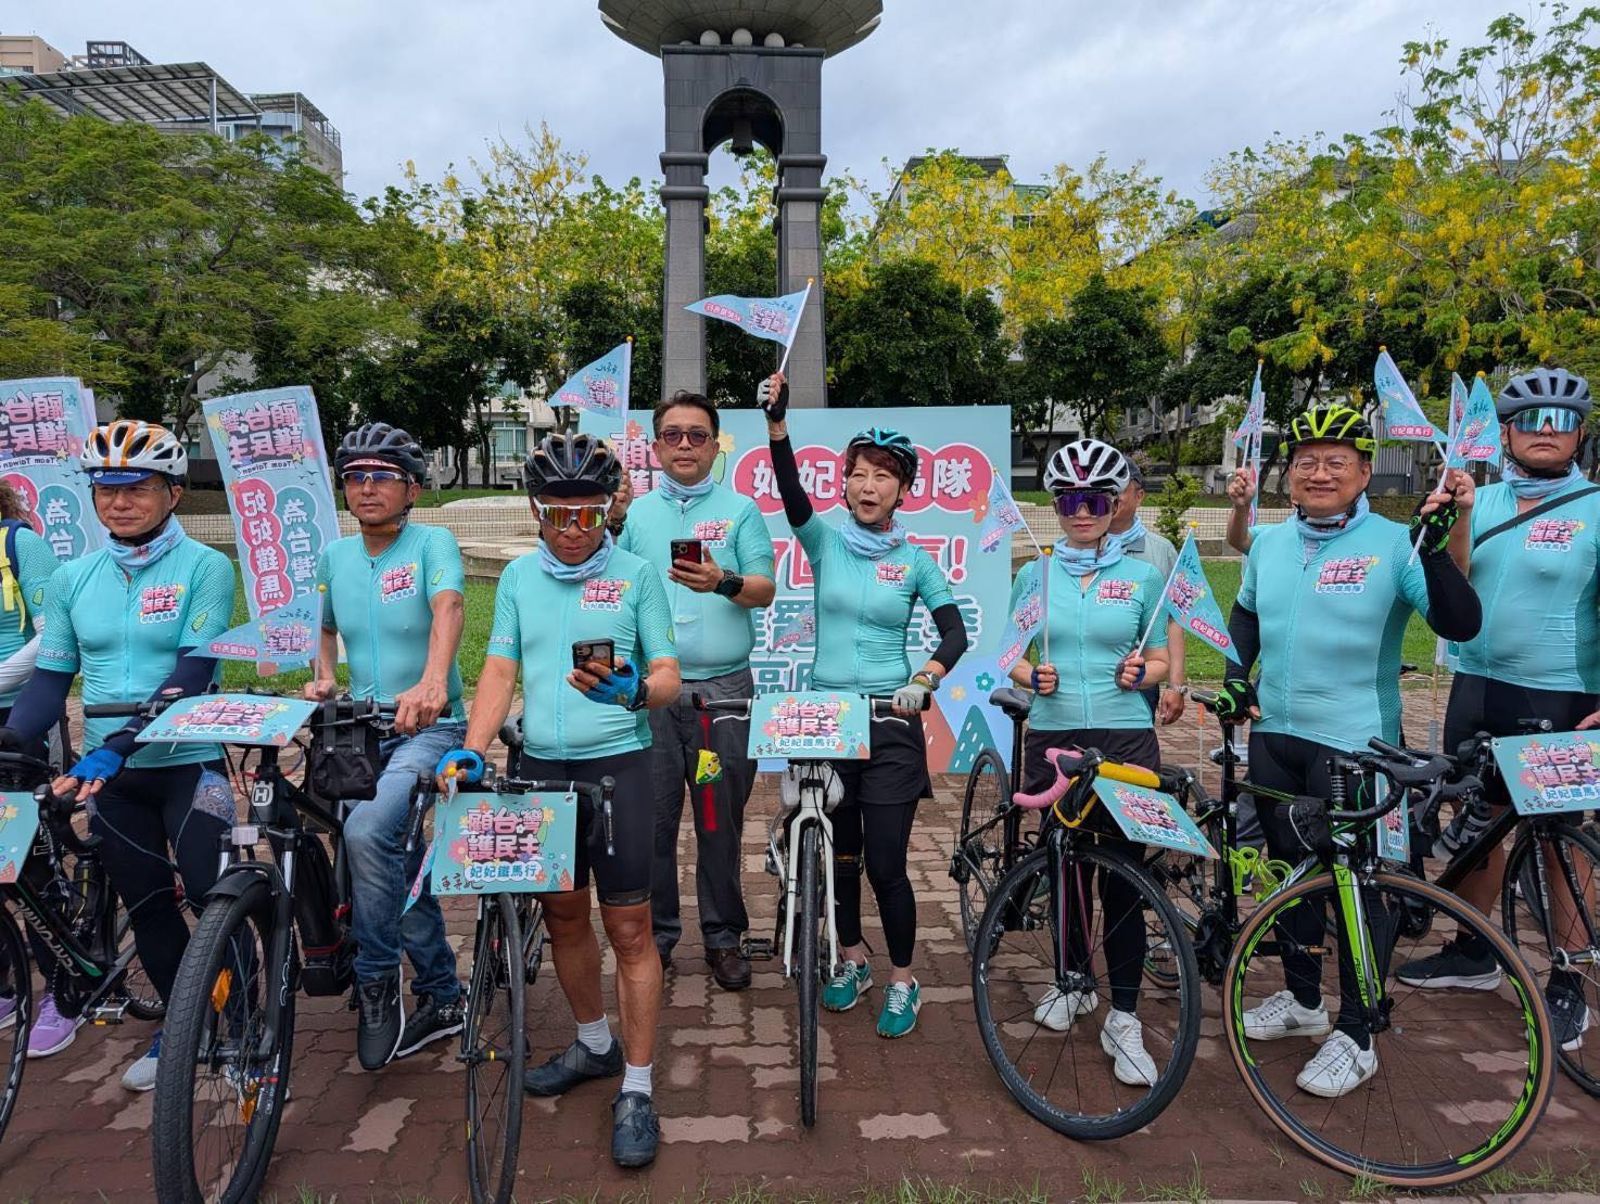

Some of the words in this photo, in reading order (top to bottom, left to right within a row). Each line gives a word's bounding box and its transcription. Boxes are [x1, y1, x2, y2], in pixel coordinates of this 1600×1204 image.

[467, 806, 544, 834] 顧台灣
[467, 833, 542, 861] 護民主
